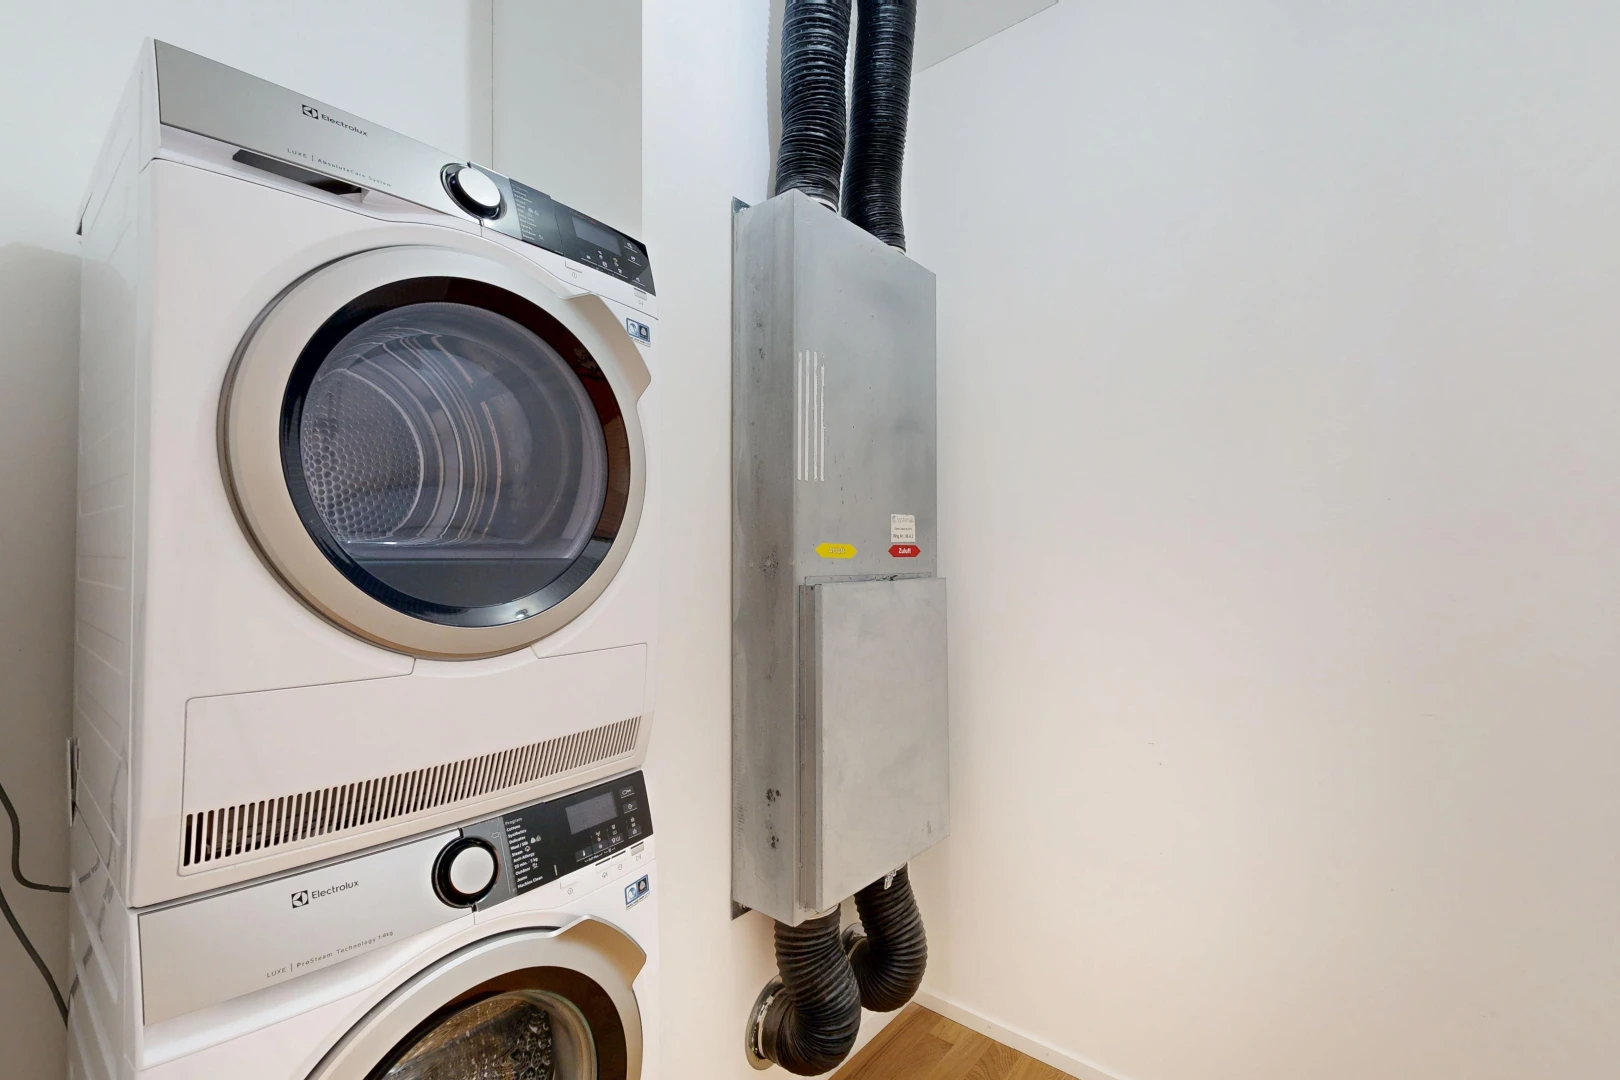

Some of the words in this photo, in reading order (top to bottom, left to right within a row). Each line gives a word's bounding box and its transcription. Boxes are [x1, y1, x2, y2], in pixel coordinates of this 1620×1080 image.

[321, 113, 368, 137] Electrolux
[287, 148, 308, 159] LUXE
[311, 880, 360, 900] Electrolux
[266, 967, 287, 979] LUXE
[296, 952, 333, 969] ProSteam
[336, 937, 377, 955] Technology
